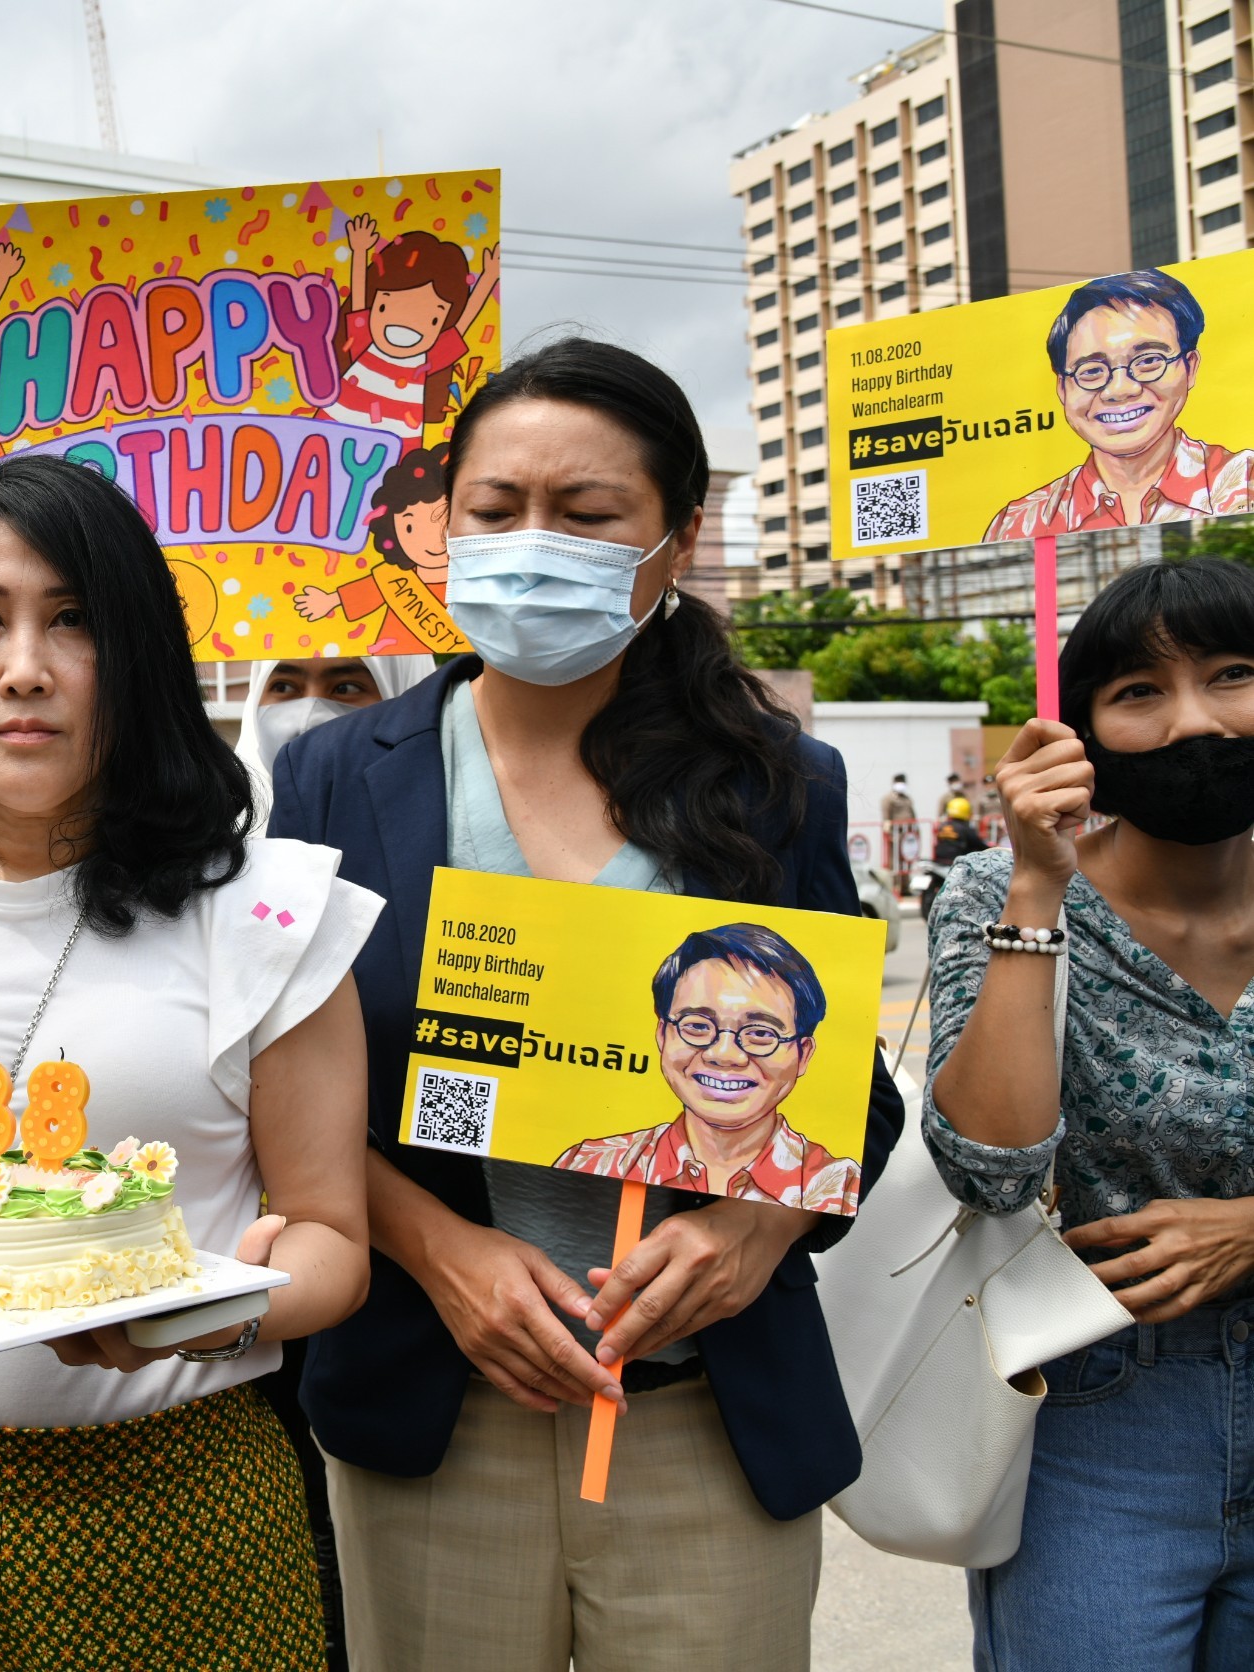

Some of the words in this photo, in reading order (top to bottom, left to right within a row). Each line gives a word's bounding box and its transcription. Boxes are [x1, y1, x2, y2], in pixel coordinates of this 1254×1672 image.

[850, 341, 922, 368] 11.08.2020
[851, 372, 893, 394] Happy
[896, 361, 953, 386] Birthday
[852, 391, 944, 418] Wanchalearm
[388, 577, 465, 652] AMNESTY
[441, 919, 516, 946] 11.08.2020
[437, 948, 481, 974] Happy
[484, 954, 544, 982] Birthday
[433, 976, 530, 1007] Wanchalearm
